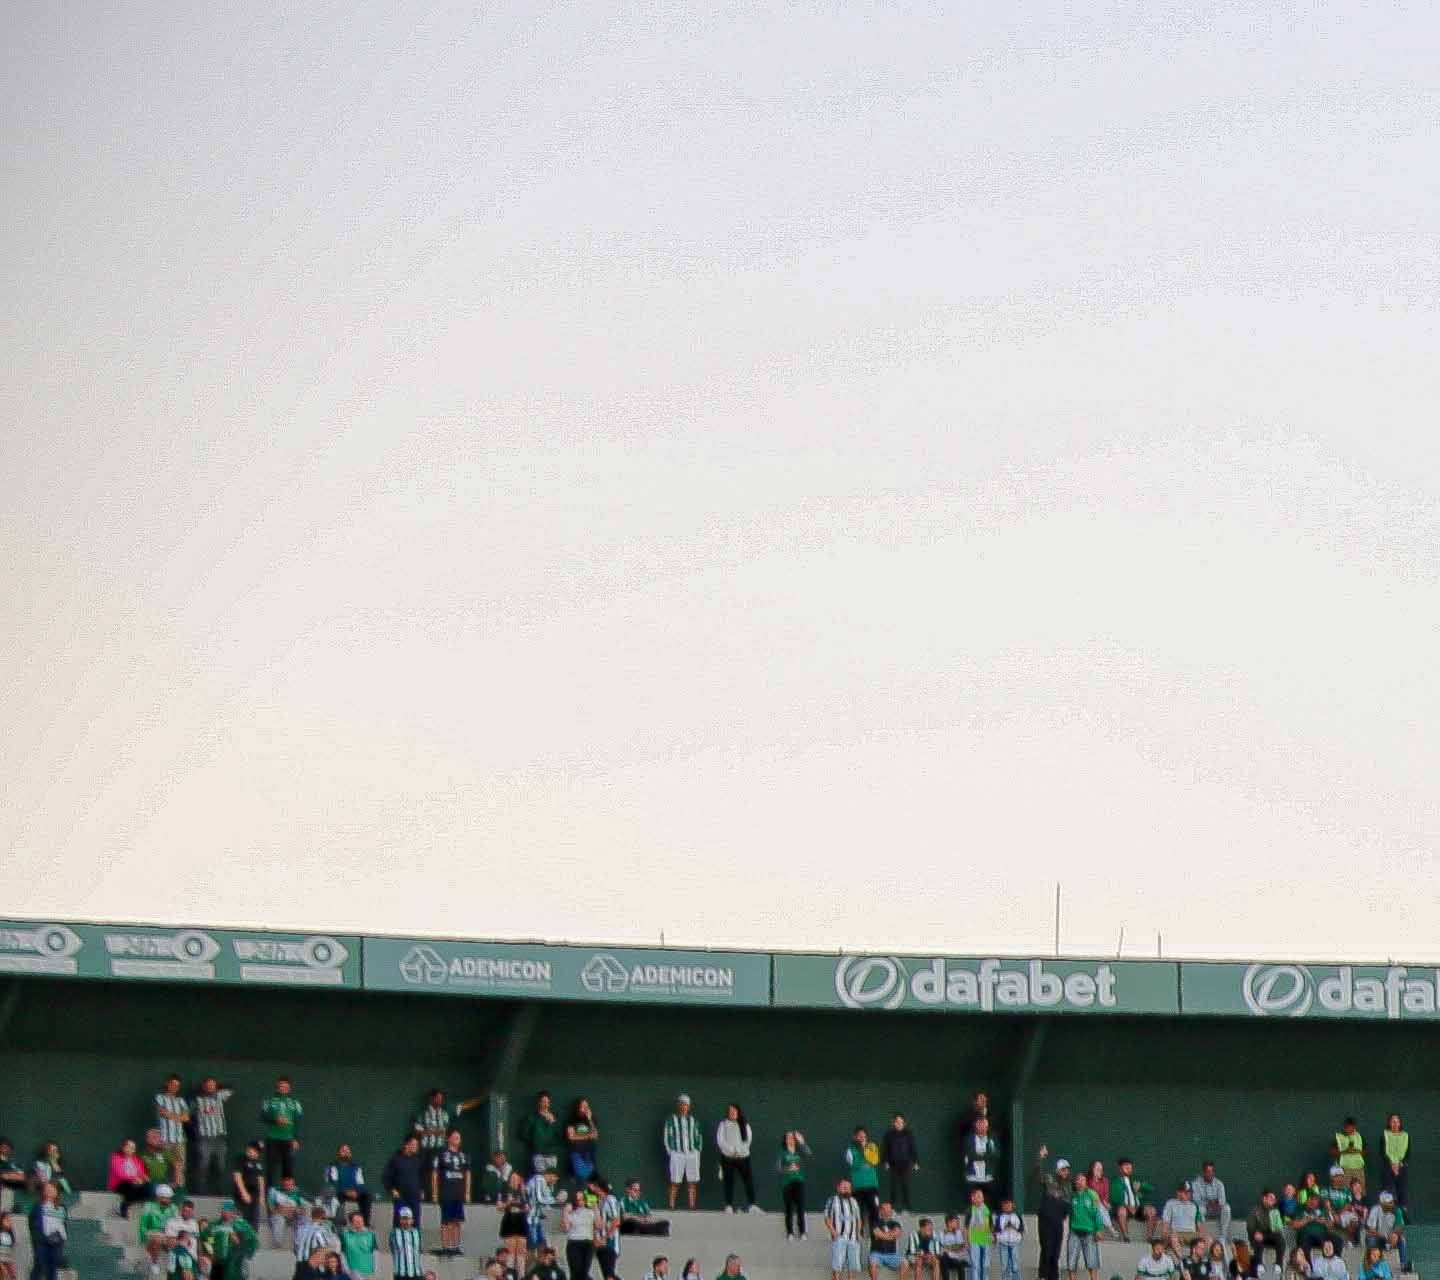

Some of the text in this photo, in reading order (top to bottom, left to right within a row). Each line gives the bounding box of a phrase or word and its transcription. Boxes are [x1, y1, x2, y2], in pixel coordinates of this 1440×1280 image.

[449, 956, 552, 981] ADEMICON
[631, 964, 735, 987] ADEMICON
[910, 957, 1117, 1011] dafabet
